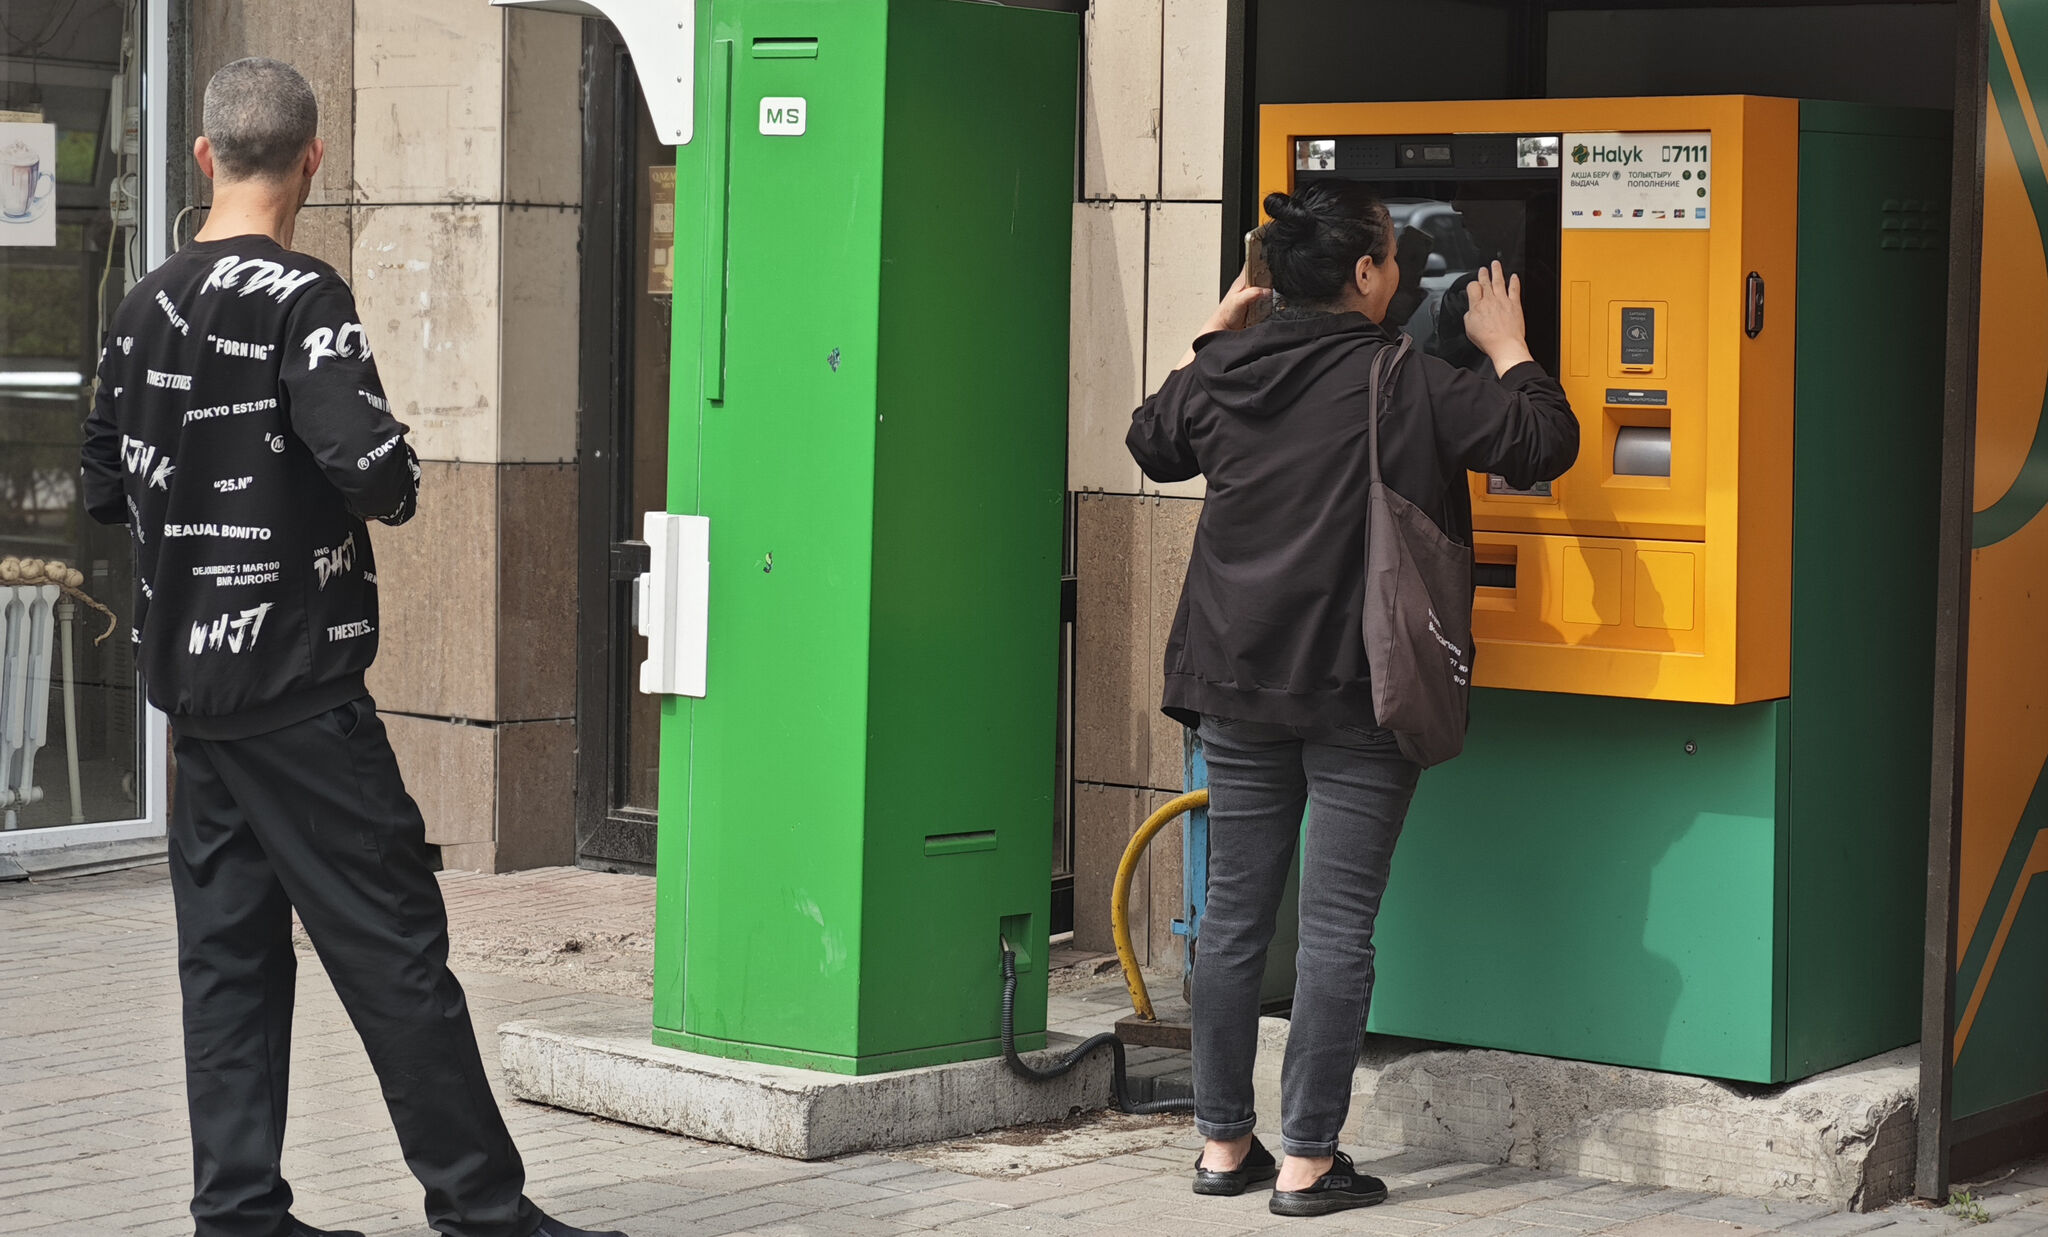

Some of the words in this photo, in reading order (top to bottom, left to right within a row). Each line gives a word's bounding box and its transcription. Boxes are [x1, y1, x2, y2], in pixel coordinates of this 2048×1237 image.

[767, 108, 800, 124] MS
[1592, 145, 1644, 166] Halyk
[1671, 145, 1707, 163] 7111
[1592, 171, 1611, 180] БЕРУ
[1570, 180, 1600, 188] ВЫДАЧА
[1627, 180, 1680, 188] ПОПОЛНЕНИЕ
[186, 405, 229, 422] TOKYO
[164, 523, 220, 537] SEAUAL
[221, 525, 272, 541] BONITO
[233, 572, 280, 586] AURORE
